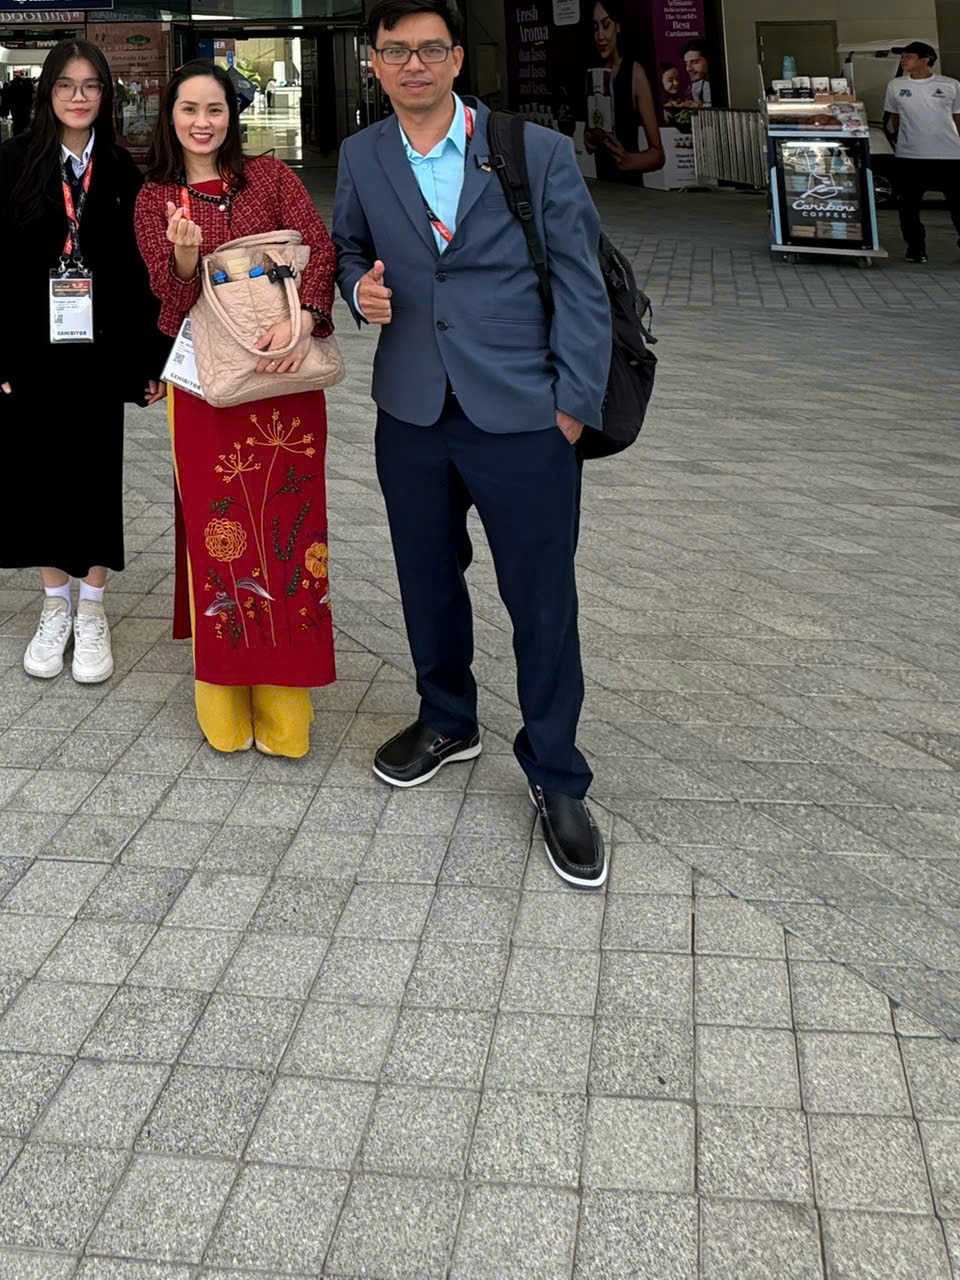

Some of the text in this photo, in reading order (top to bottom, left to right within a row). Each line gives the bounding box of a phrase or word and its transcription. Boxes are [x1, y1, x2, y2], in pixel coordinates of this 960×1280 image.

[516, 4, 538, 23] Fresh
[672, 20, 690, 29] Best
[520, 25, 549, 43] Aroma
[792, 200, 856, 211] Caribou
